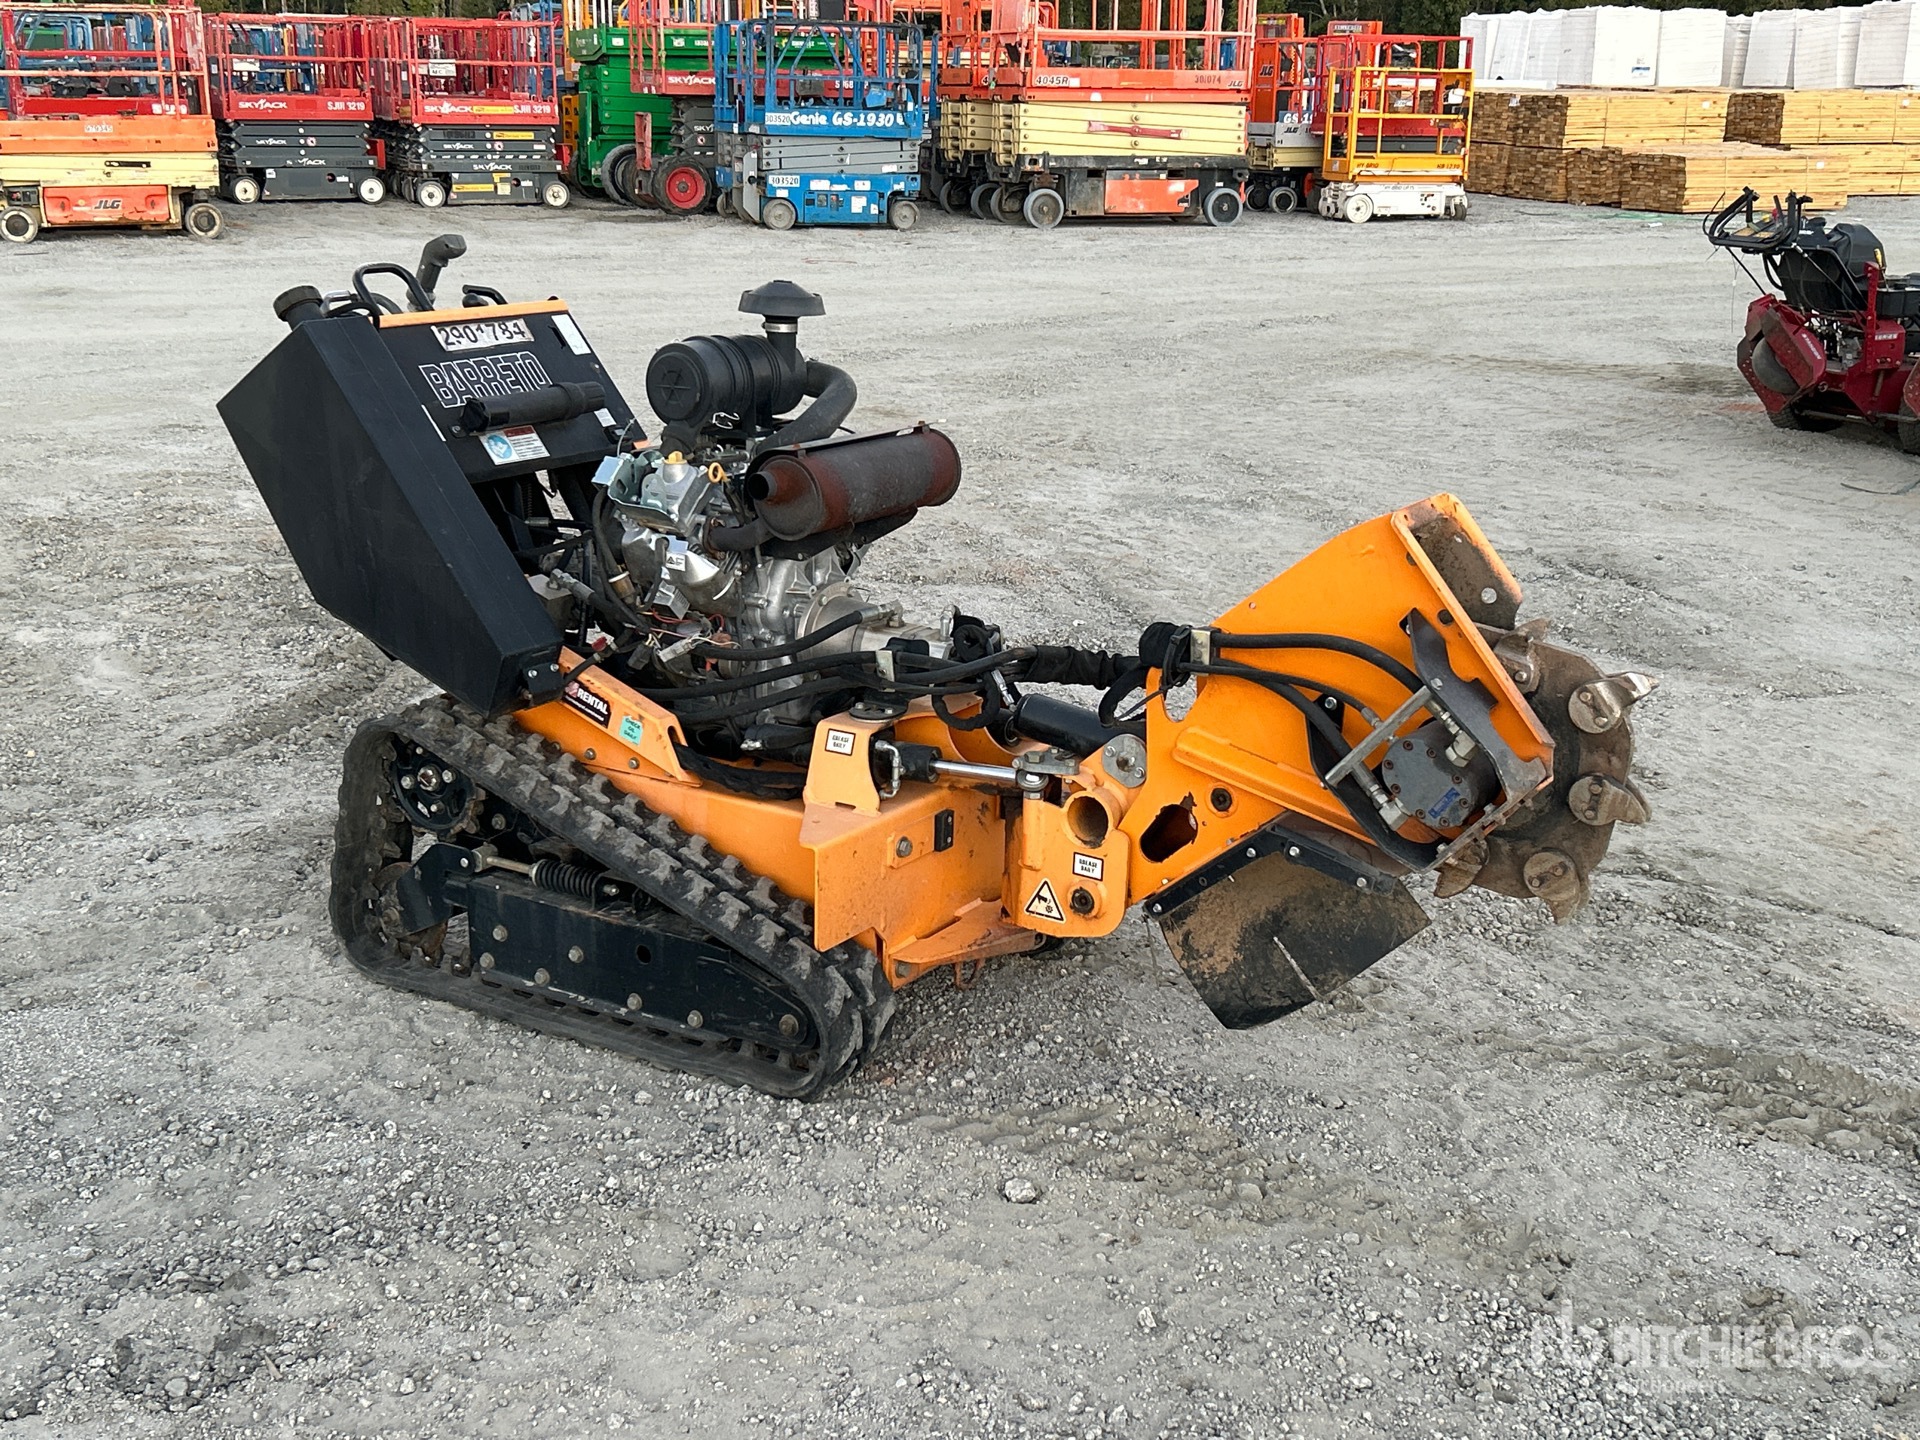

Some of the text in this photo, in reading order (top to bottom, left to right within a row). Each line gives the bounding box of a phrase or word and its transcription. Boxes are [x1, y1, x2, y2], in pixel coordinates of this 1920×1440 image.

[667, 75, 715, 86] SKYJACK
[238, 99, 288, 110] SKYJACK
[346, 101, 366, 111] 3219
[532, 105, 551, 114] 3219
[790, 110, 829, 126] Genie
[832, 112, 895, 128] GS-1930
[473, 162, 513, 171] SKYJACK
[93, 199, 122, 210] JLG
[419, 352, 553, 408] BARRETO
[577, 688, 608, 714] RENTAL
